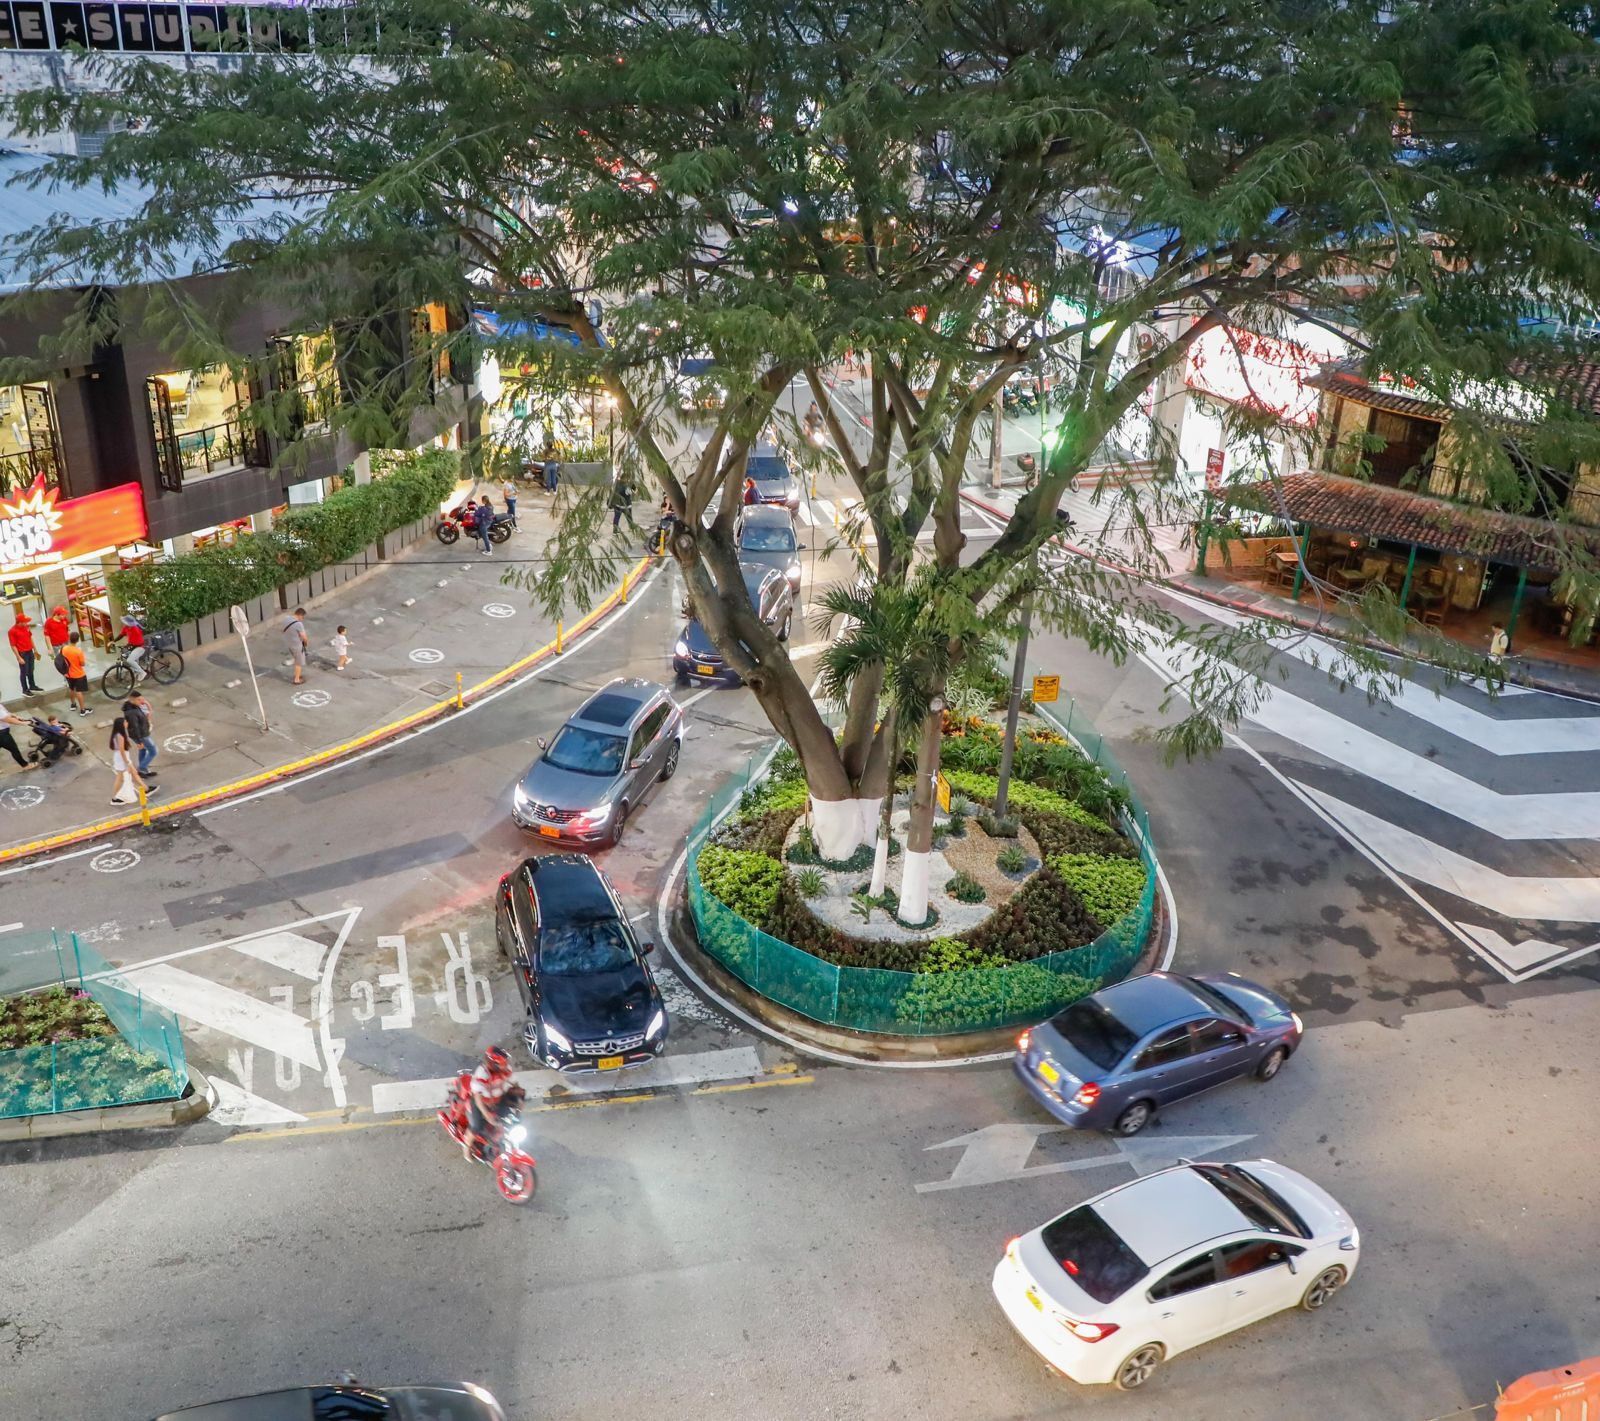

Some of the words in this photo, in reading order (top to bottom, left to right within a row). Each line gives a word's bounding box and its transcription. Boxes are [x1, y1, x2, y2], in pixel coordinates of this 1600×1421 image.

[89, 12, 277, 43] STUDIO
[0, 514, 48, 541] ISPA
[377, 932, 480, 1030] RE
